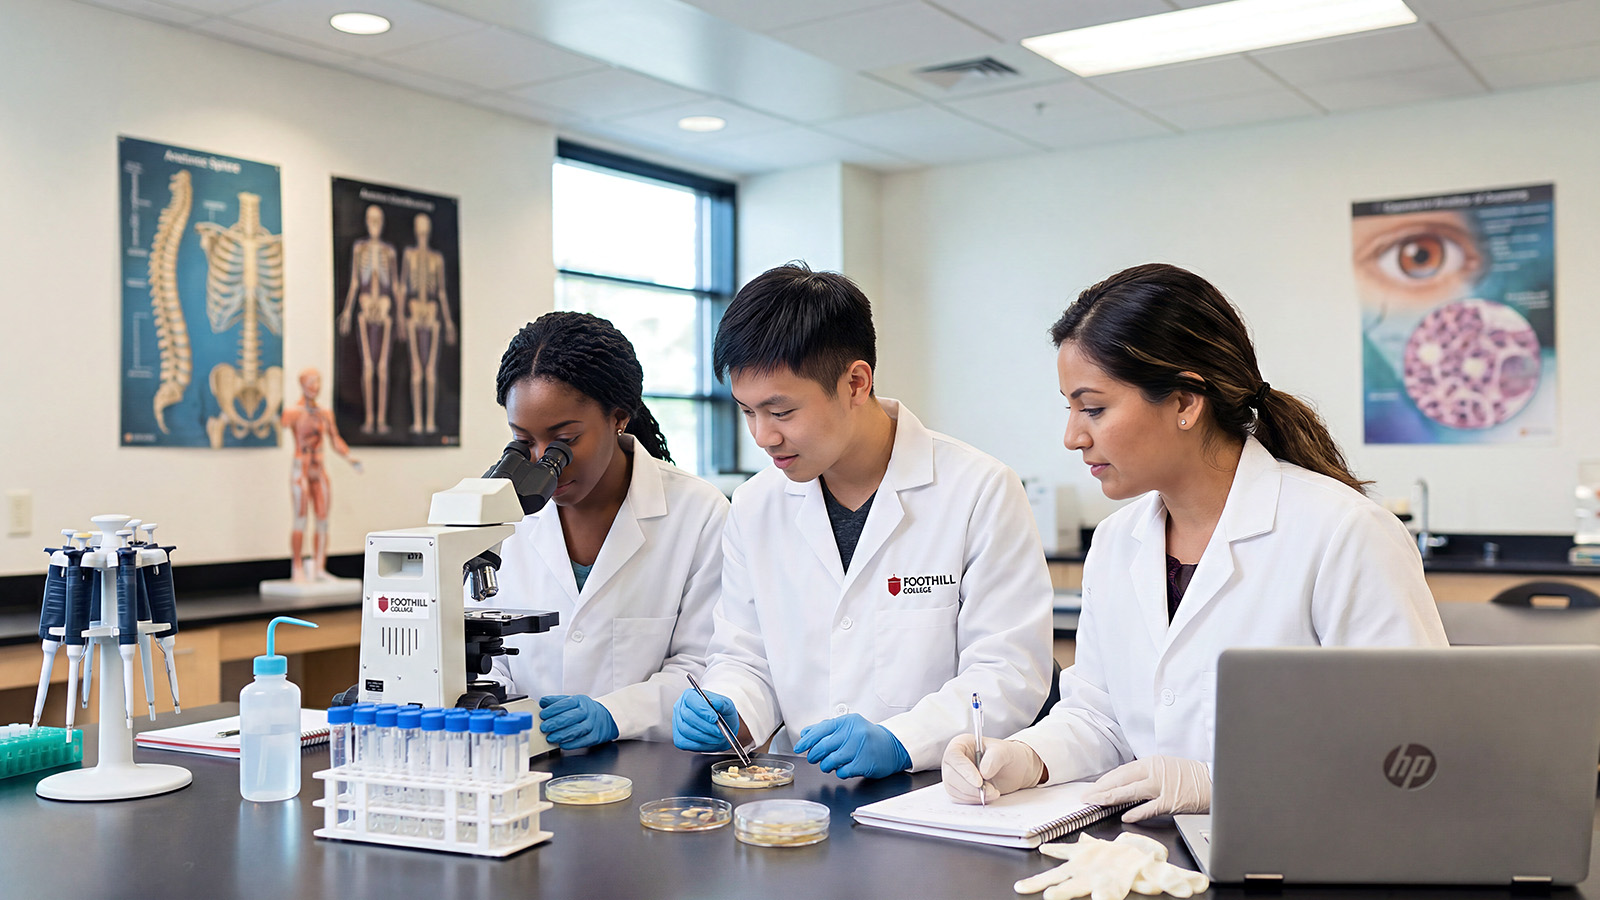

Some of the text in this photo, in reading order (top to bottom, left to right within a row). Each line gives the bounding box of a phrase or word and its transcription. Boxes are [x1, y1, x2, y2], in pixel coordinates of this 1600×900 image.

[903, 575, 956, 587] FOOTHILL
[390, 598, 428, 607] FOOTHILL
[1388, 743, 1432, 790] hp
